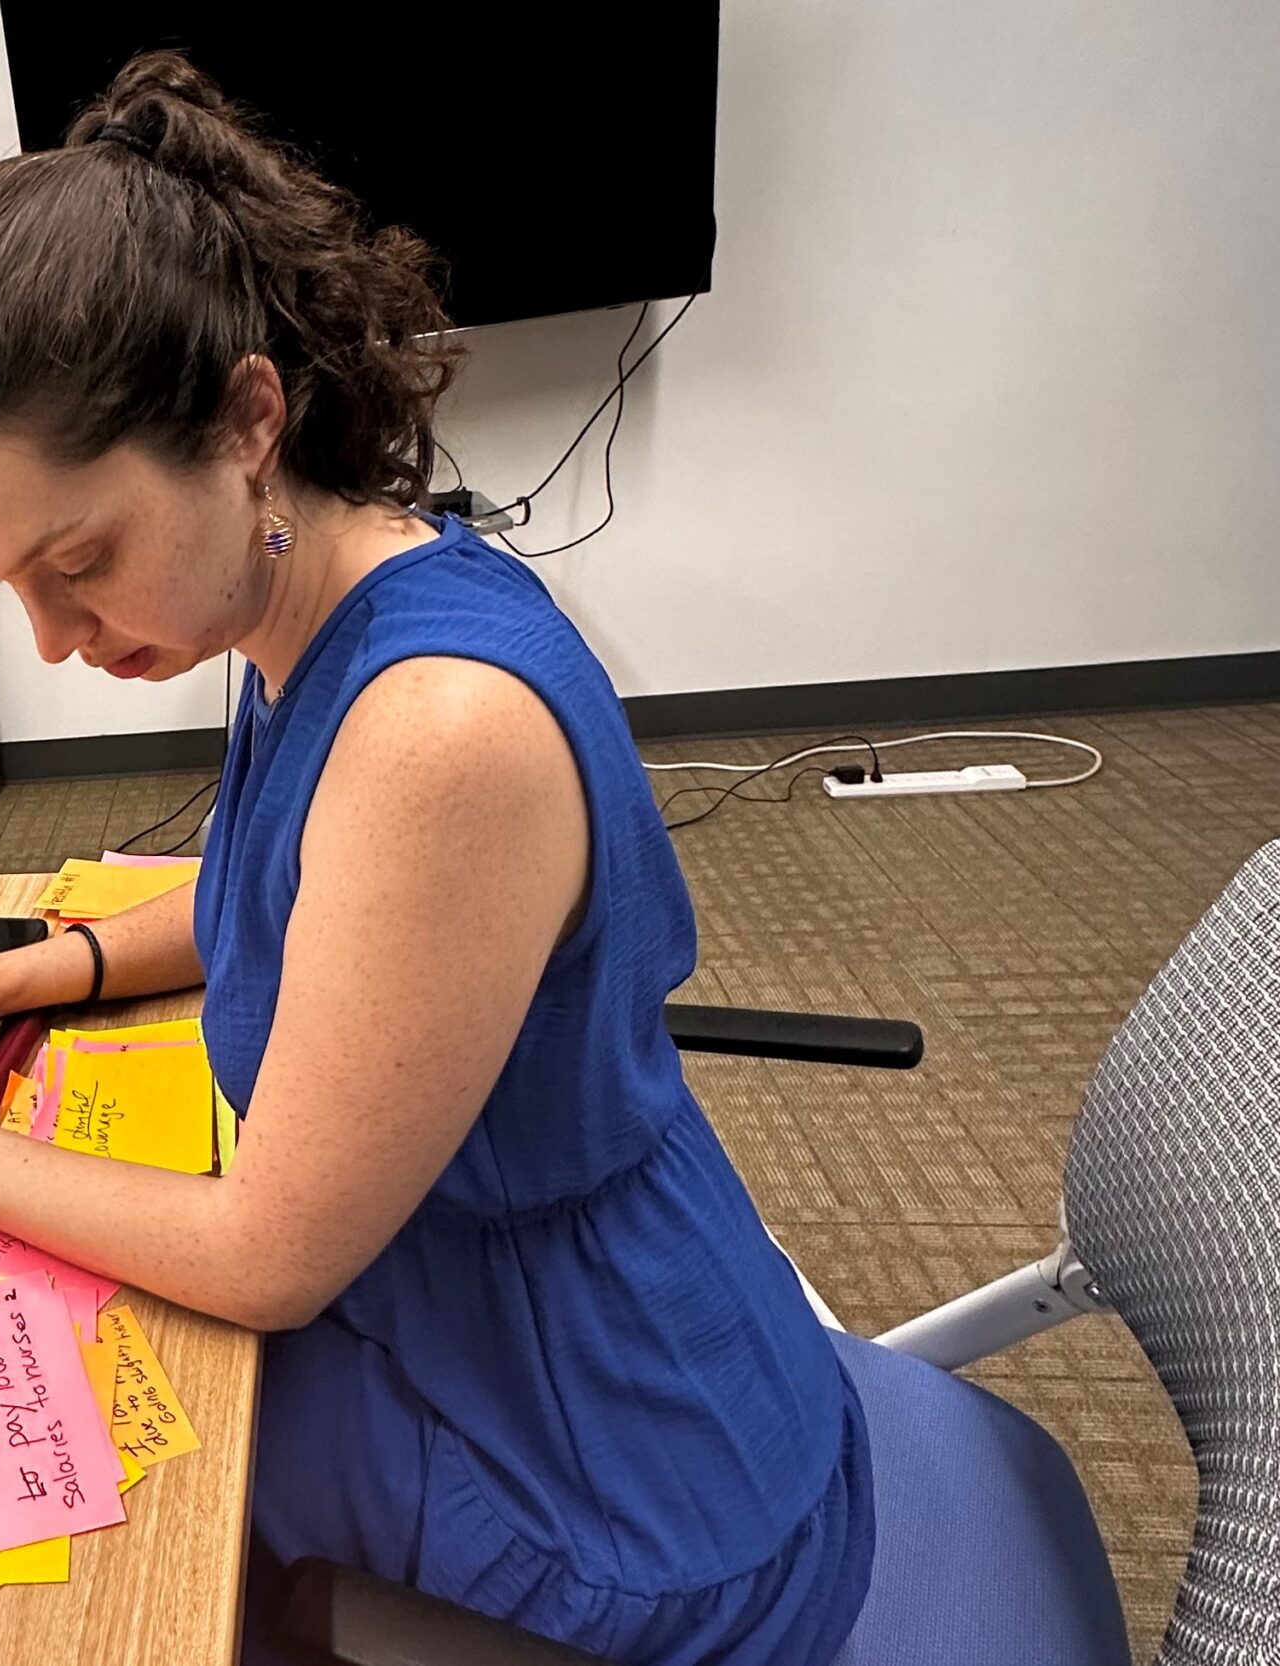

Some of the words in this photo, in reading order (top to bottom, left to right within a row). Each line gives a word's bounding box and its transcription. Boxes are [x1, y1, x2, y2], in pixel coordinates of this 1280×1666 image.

[10, 1311, 43, 1381] nurses
[9, 1403, 46, 1448] pay
[47, 1419, 85, 1509] salaries
